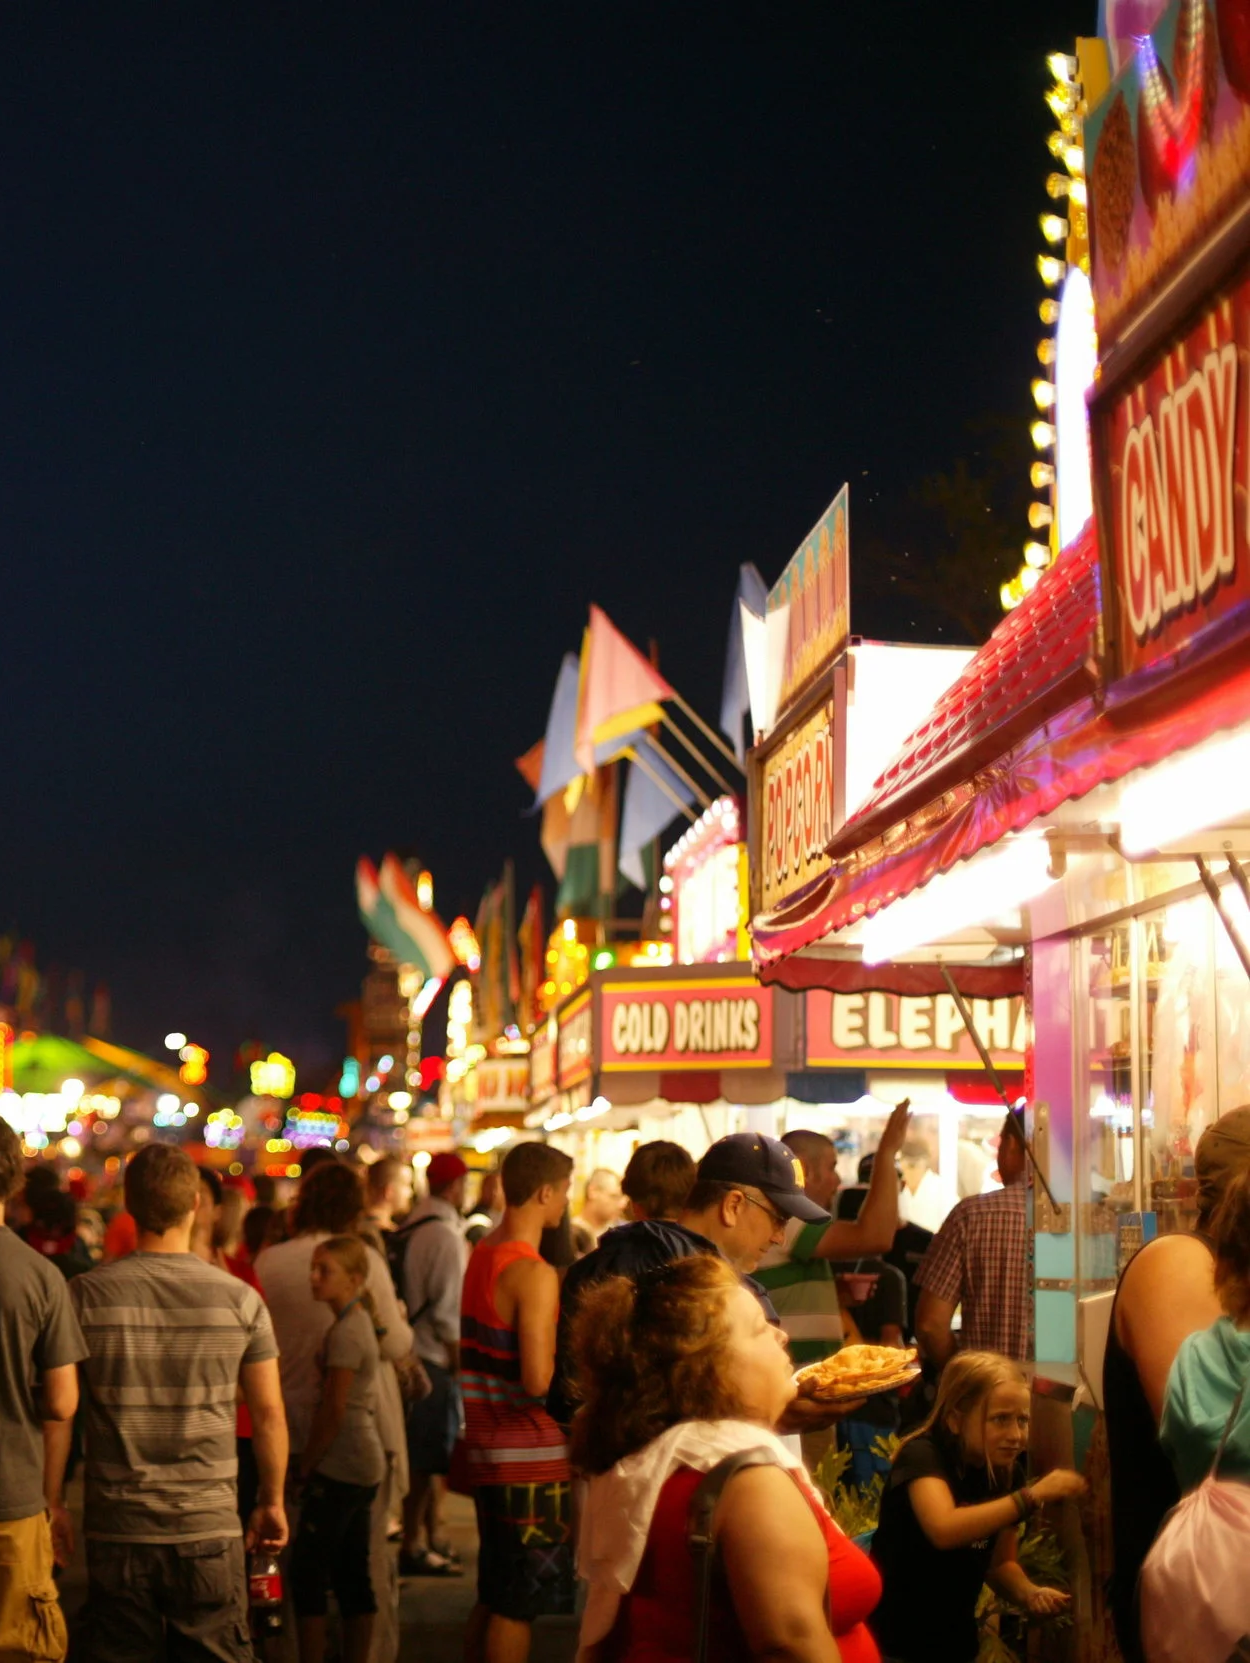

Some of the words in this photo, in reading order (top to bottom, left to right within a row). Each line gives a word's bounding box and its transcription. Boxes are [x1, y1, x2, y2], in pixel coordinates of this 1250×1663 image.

[1121, 342, 1237, 637] CANDY
[611, 1000, 669, 1054] COLD
[674, 997, 760, 1053] DRINKS
